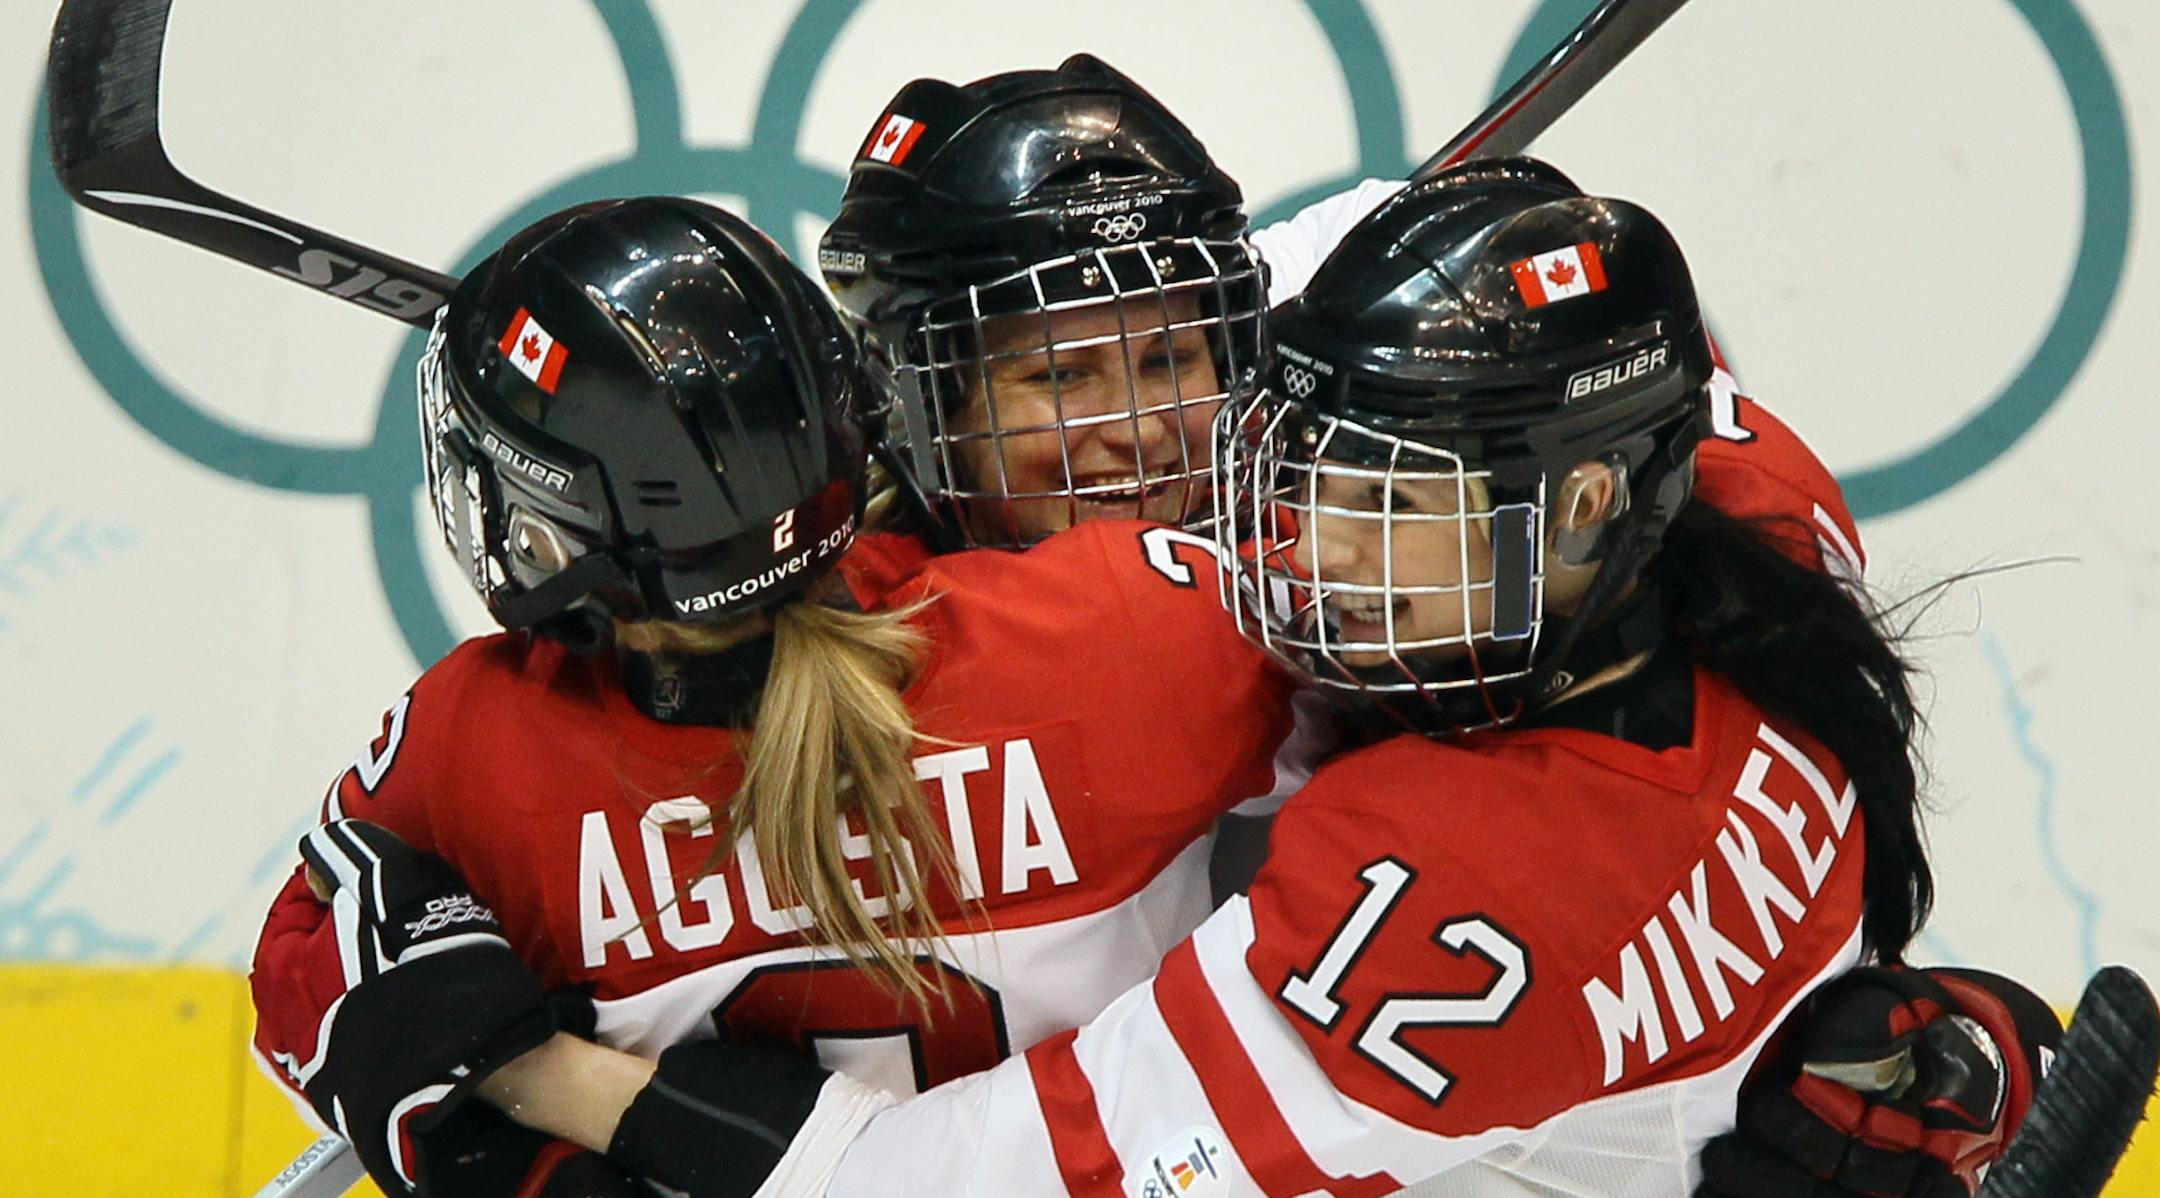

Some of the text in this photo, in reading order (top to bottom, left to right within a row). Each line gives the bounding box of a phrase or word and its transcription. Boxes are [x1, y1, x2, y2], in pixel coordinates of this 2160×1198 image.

[1067, 194, 1163, 217] vancouver 2010
[272, 248, 445, 319] S19
[675, 513, 855, 615] vancouver 2010
[773, 507, 796, 553] 2
[1581, 721, 1858, 1087] MIKKEL
[1279, 857, 1531, 1101] 12
